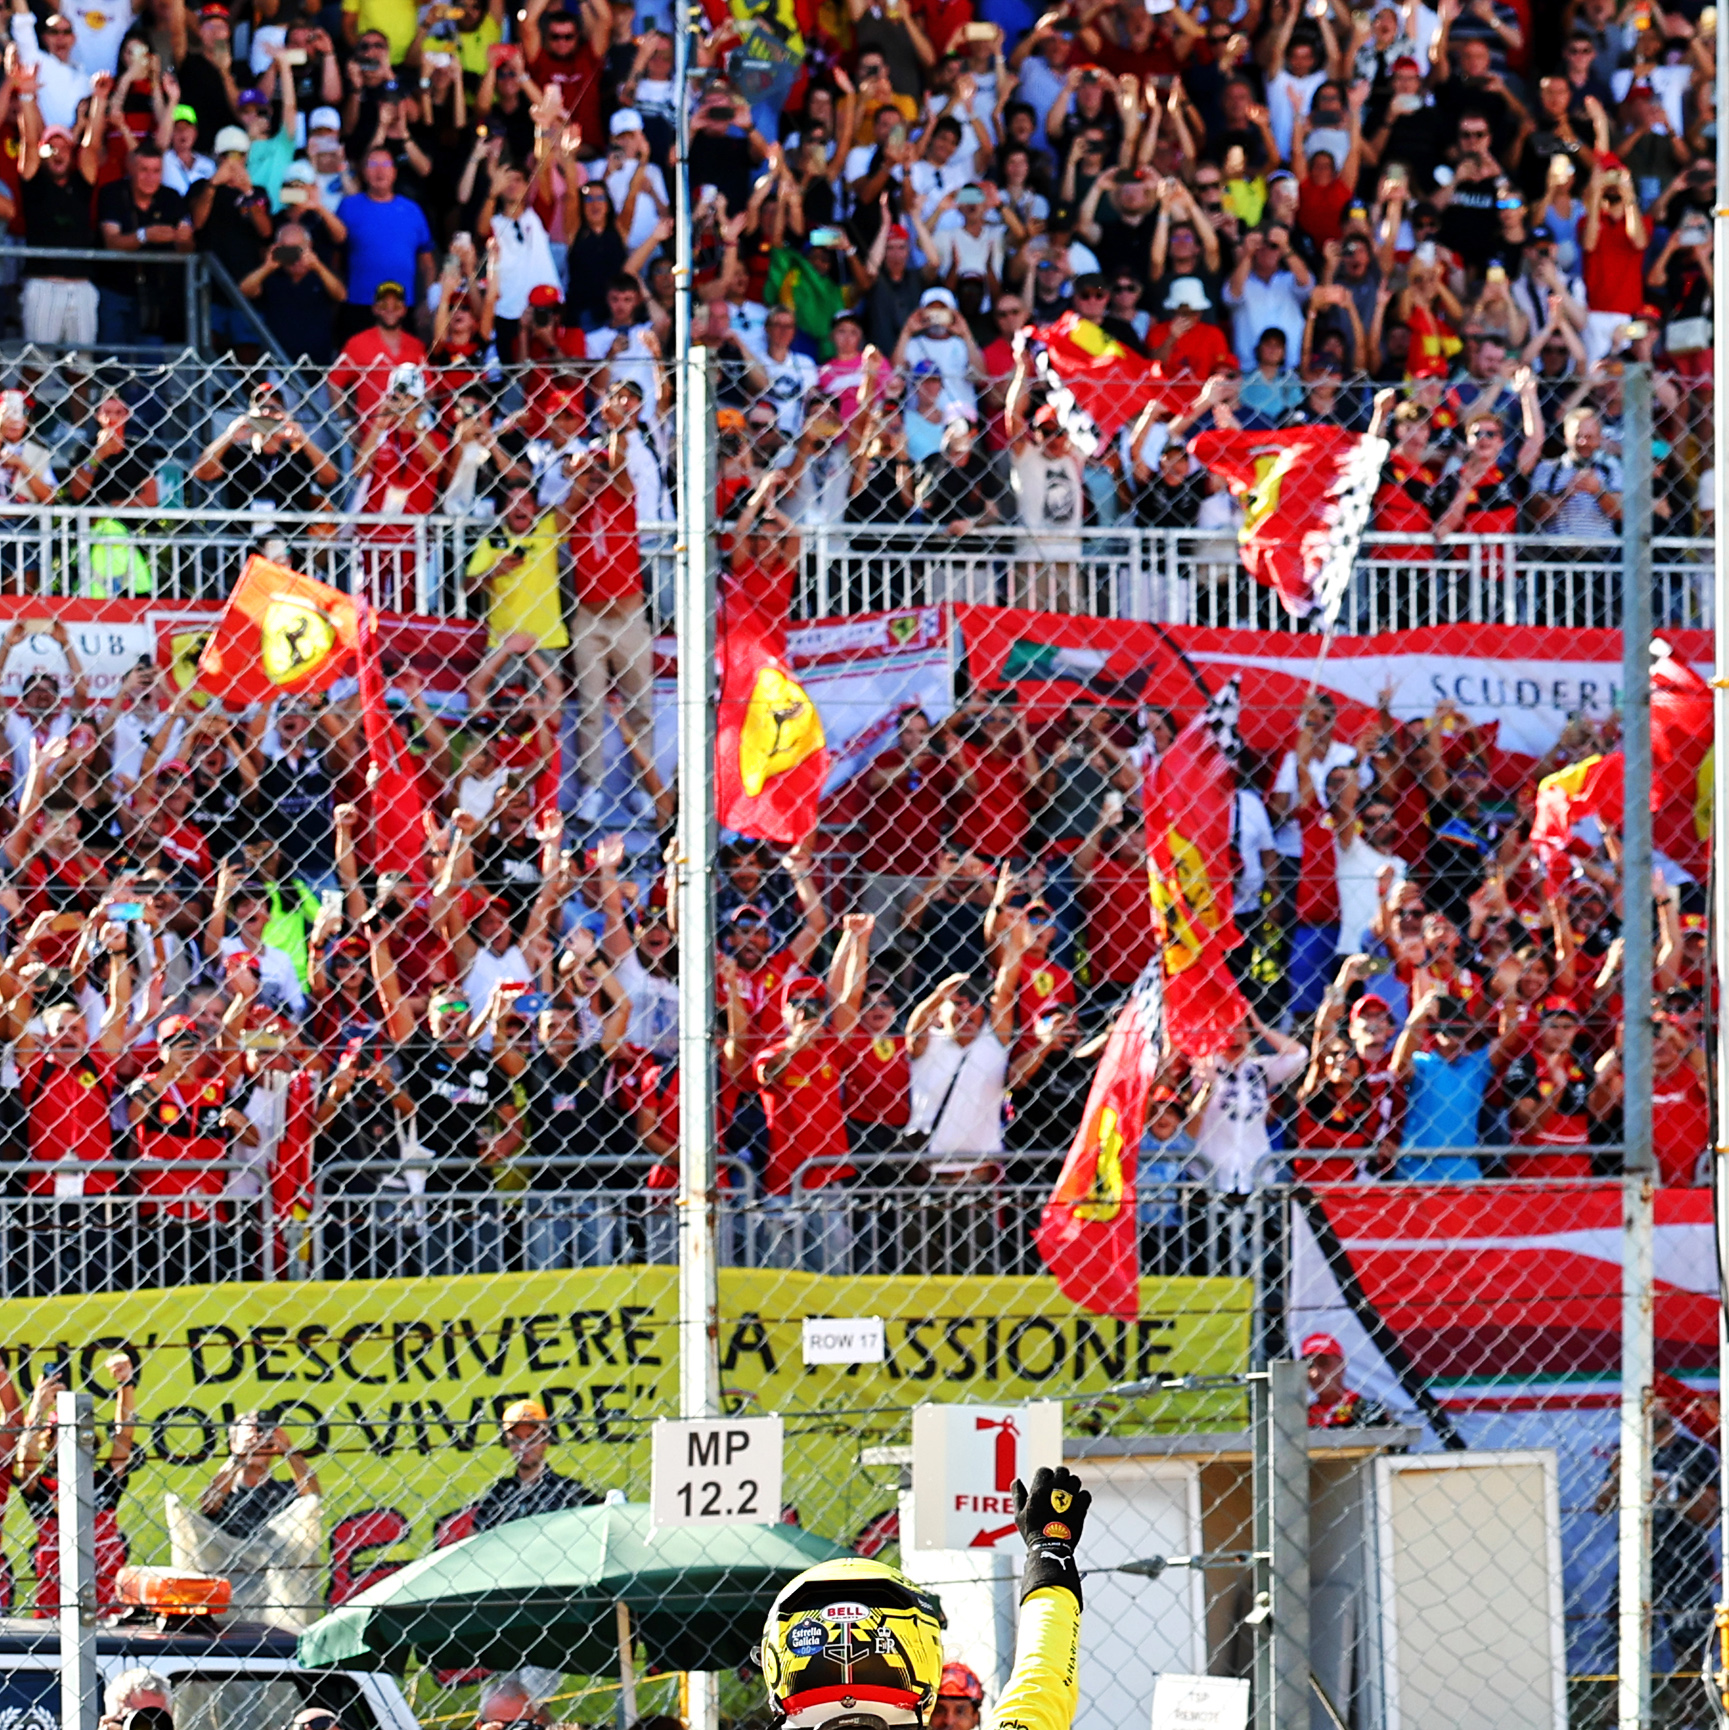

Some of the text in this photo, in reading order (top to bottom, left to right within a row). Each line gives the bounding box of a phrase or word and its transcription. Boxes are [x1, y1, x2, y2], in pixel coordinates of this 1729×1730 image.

[1432, 673, 1620, 711] SCUDERI
[186, 1306, 663, 1385] DESCRIVERE
[809, 1331, 878, 1351] ROW 17
[687, 1430, 751, 1468] MP
[676, 1479, 759, 1518] 12.2
[827, 1607, 864, 1617] BELL
[791, 1627, 822, 1638] Estrella
[792, 1637, 821, 1648] Galicia
